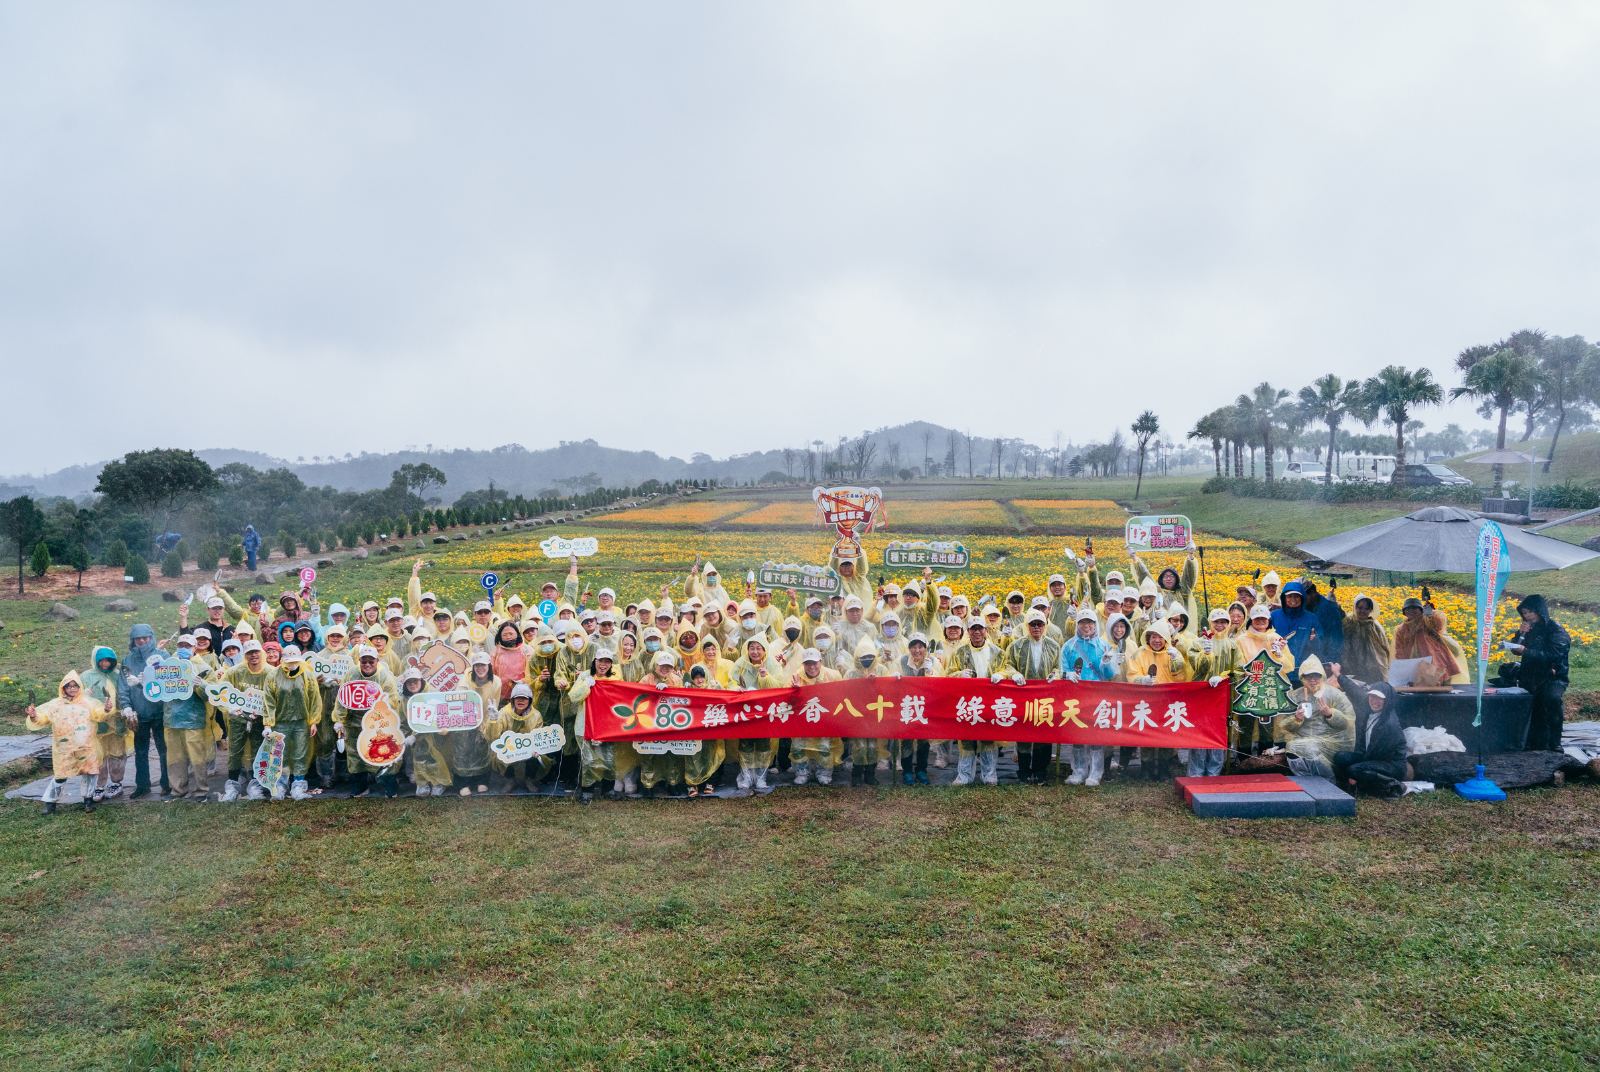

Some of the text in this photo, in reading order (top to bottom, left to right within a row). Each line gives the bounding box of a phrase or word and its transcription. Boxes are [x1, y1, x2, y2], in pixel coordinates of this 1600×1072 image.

[1151, 525, 1185, 537] 順一順
[1150, 536, 1186, 548] 我的運
[304, 570, 312, 580] E
[485, 576, 494, 586] C
[543, 603, 552, 614] F
[473, 627, 483, 638] D
[155, 665, 182, 680] 順到
[314, 661, 331, 674] 80
[228, 692, 246, 706] 80
[437, 701, 475, 716] 順一順
[955, 695, 1195, 732] 綠意順天創未來
[437, 713, 477, 729] 我的運
[656, 703, 692, 728] 80
[533, 728, 559, 742] 順天堂
[514, 737, 532, 749] 80
